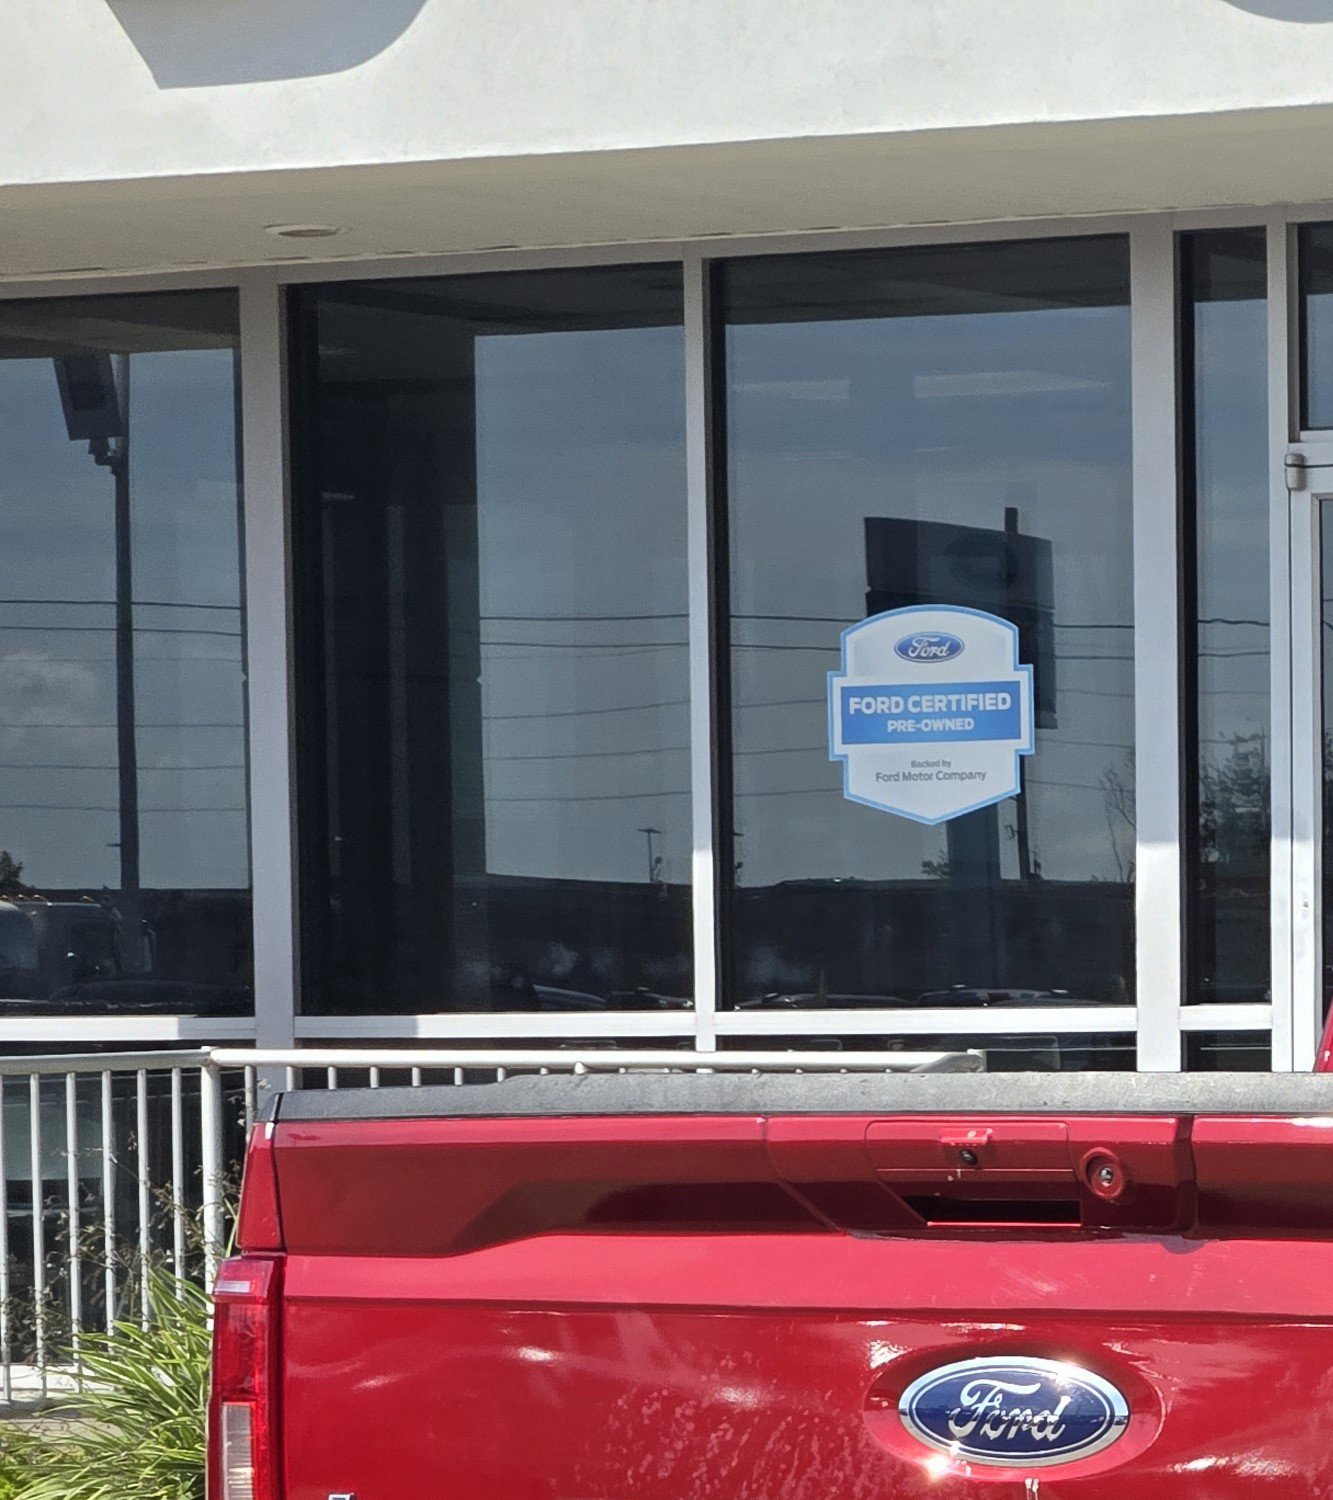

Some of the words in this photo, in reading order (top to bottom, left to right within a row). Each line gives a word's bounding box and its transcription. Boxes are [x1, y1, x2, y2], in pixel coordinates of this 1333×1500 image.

[909, 637, 949, 657] Ford
[849, 697, 904, 715] FORD
[907, 693, 1012, 712] CERTIFIED
[887, 719, 974, 733] PRE-OWNED
[911, 759, 941, 769] Backed
[942, 759, 952, 769] by
[876, 772, 900, 782] Ford
[902, 772, 935, 782] Motor
[935, 770, 987, 783] Company
[947, 1379, 1073, 1442] Ford
